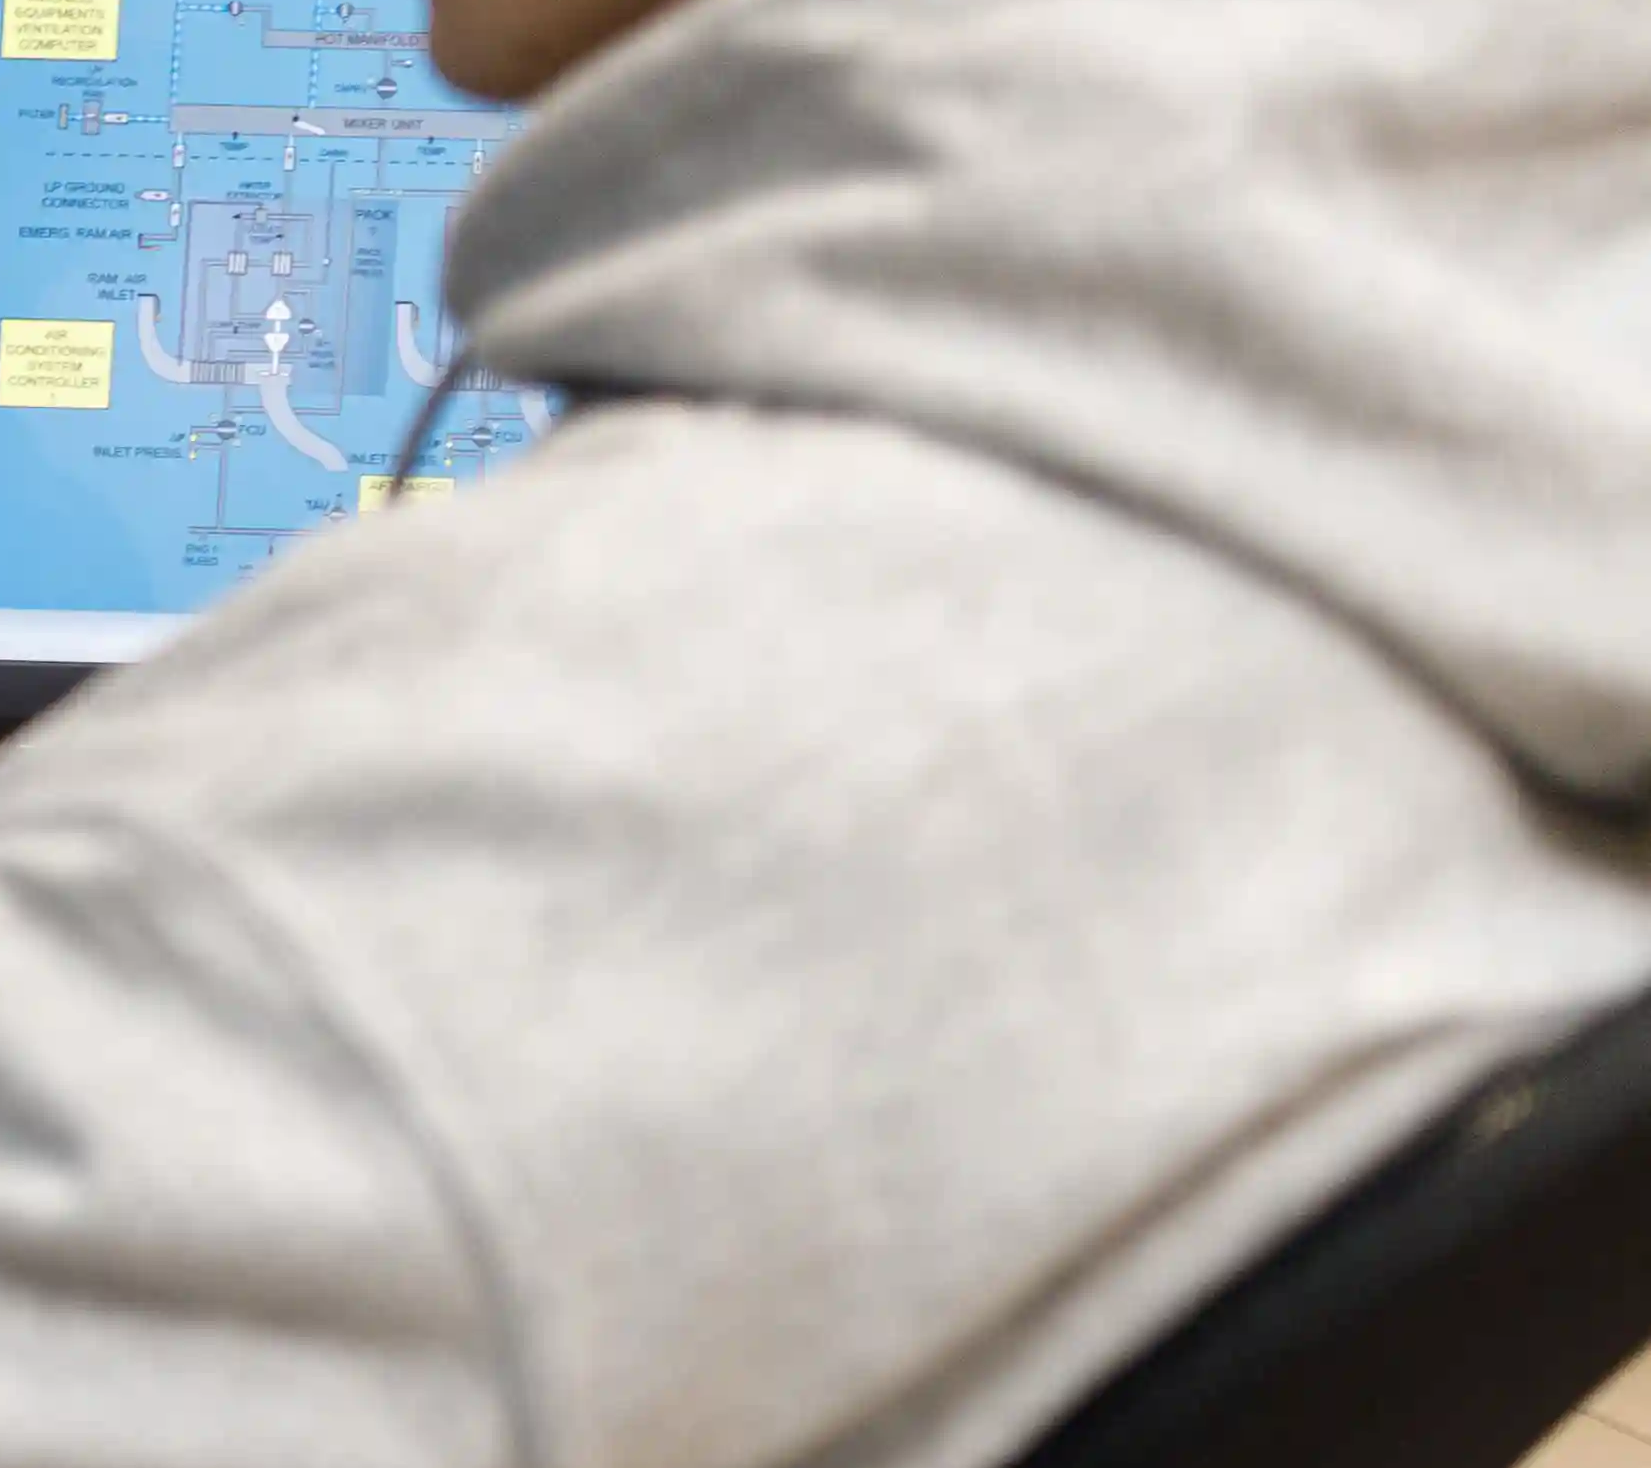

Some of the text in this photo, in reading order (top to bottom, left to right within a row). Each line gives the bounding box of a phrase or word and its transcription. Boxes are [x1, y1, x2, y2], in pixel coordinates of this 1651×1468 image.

[14, 8, 106, 20] EQUIPMENTS
[16, 24, 104, 36] VENTILATION
[18, 39, 97, 51] COMPUTER
[65, 183, 126, 194] GROUND
[41, 198, 129, 210] CONNECTOR
[18, 227, 71, 238] EMERG
[98, 289, 136, 300] INLET
[7, 376, 100, 388] CONTROLLER
